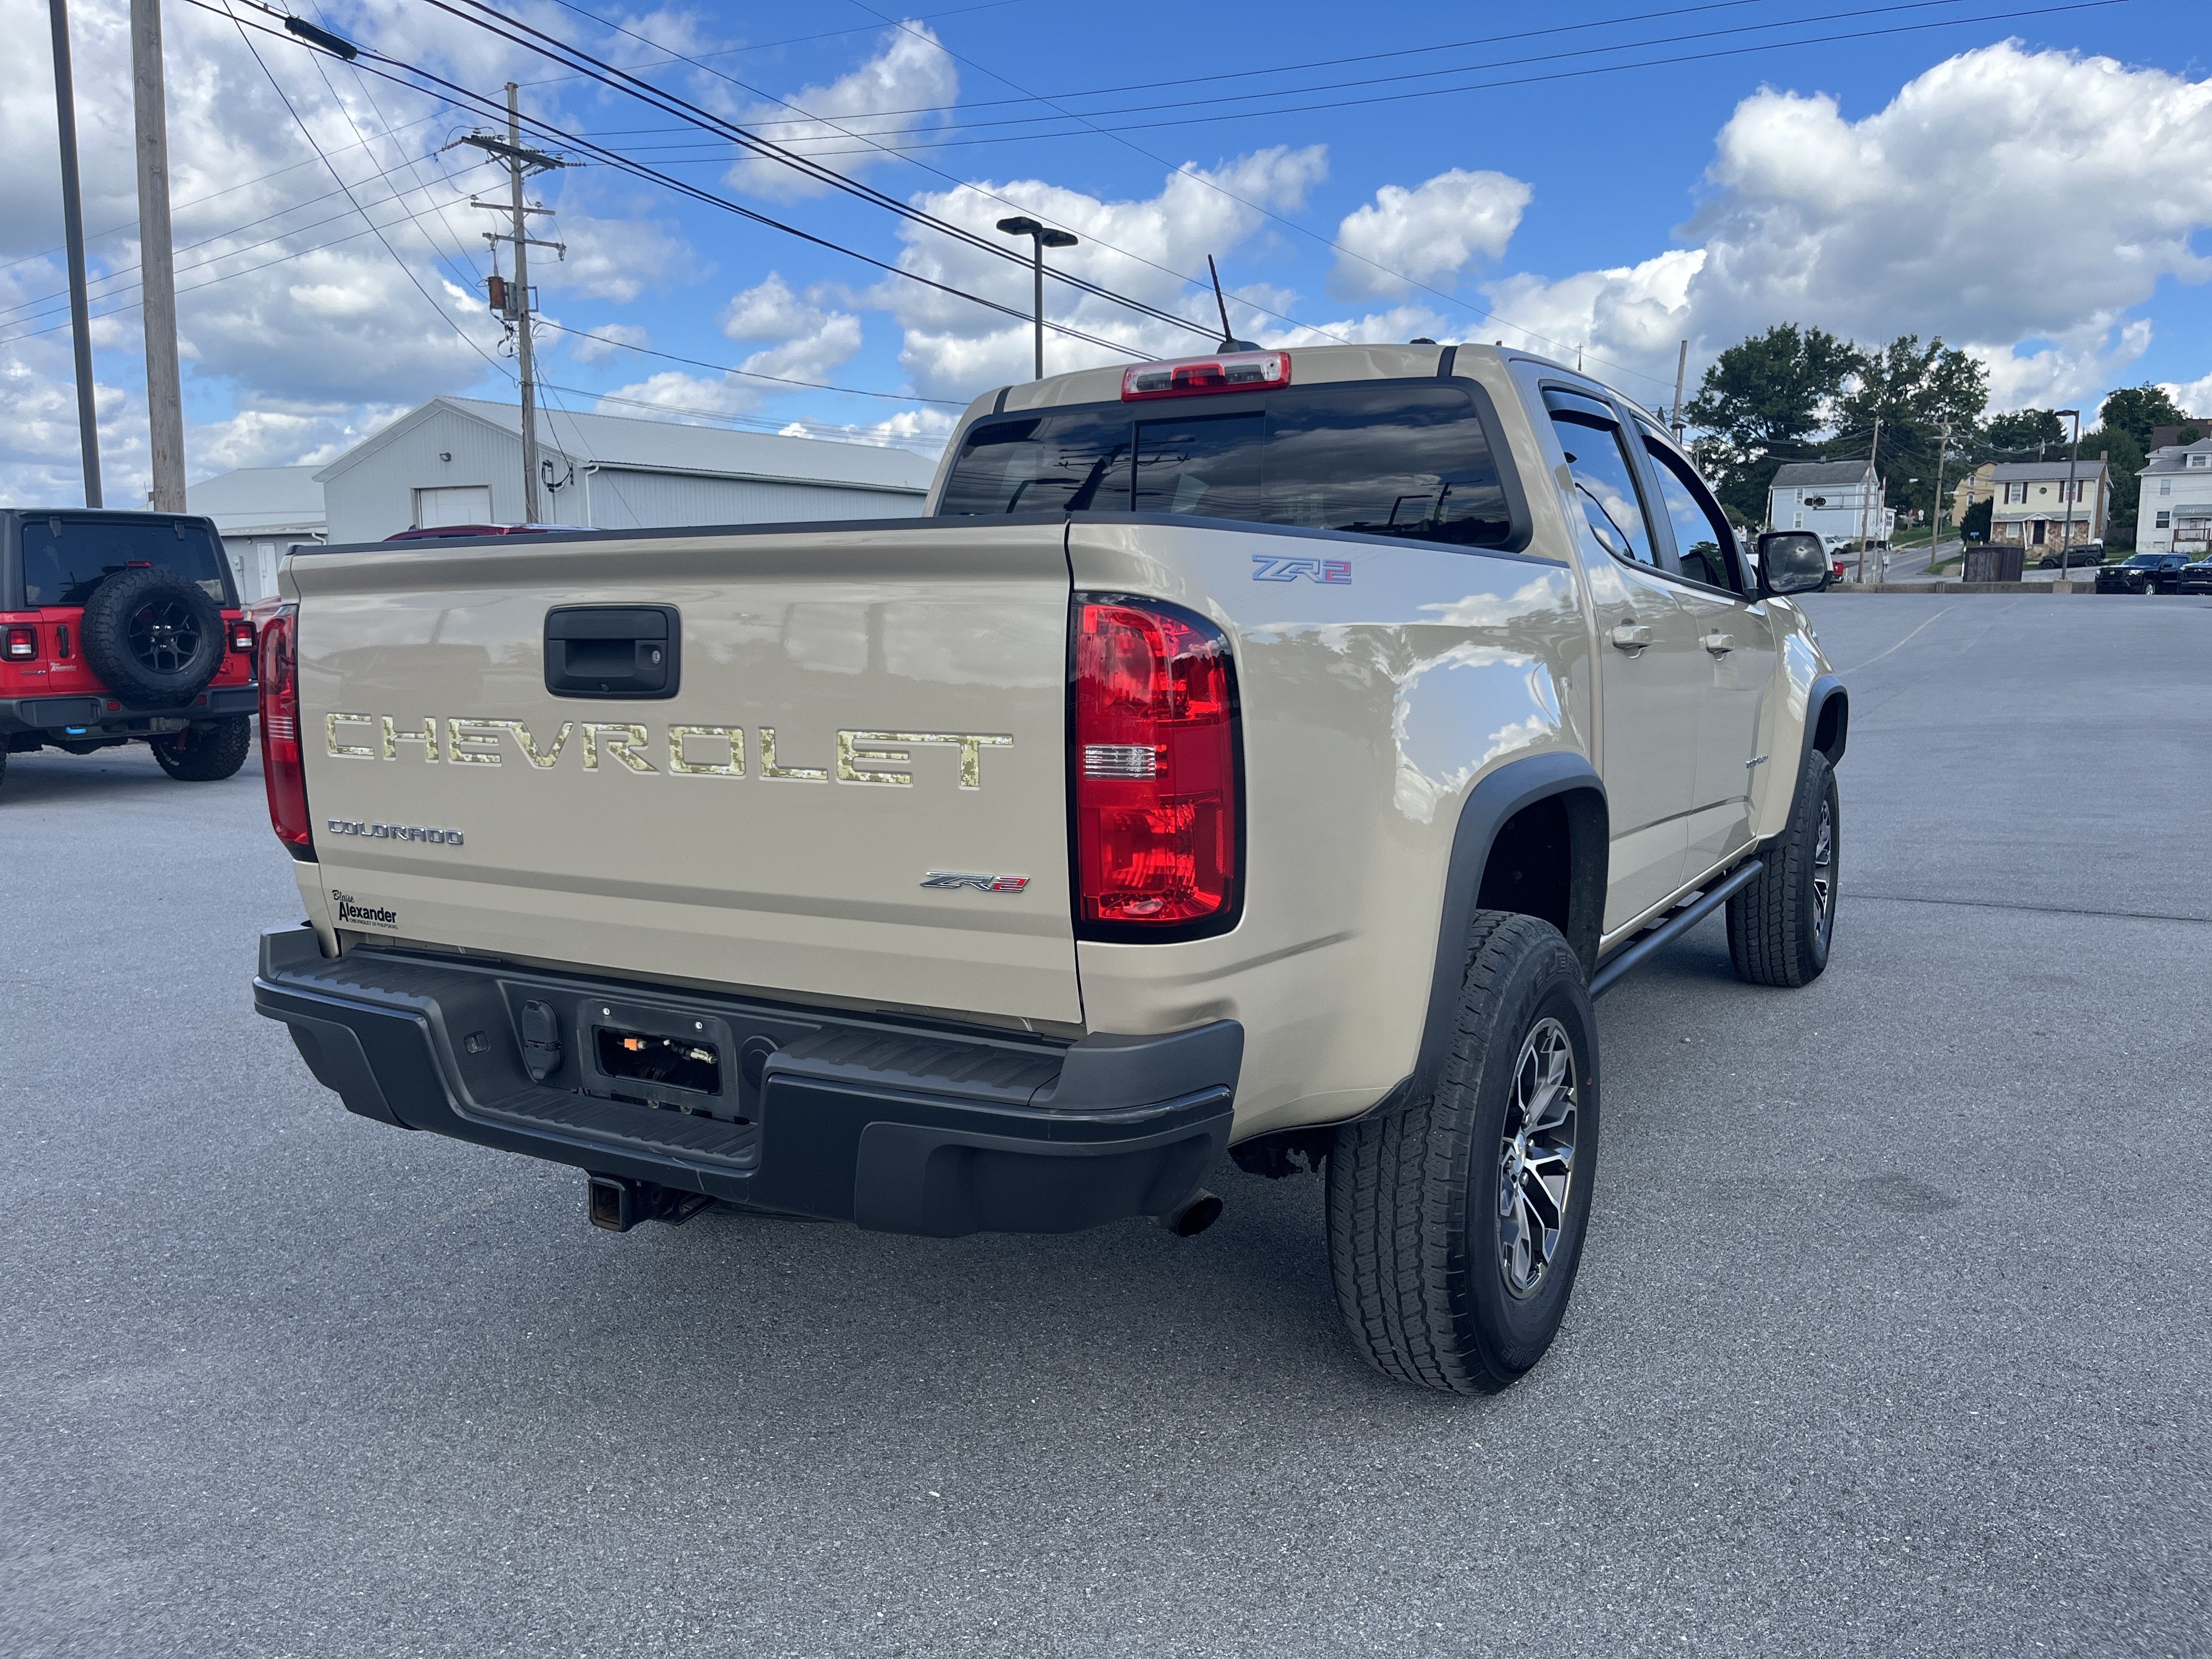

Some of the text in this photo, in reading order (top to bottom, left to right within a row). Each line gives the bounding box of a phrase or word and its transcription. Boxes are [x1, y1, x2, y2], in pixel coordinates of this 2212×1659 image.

[1251, 554, 1352, 586] ZR2
[326, 713, 1014, 788] CHEVROLET
[328, 819, 464, 845] COLORADO
[919, 871, 1031, 893] ZR2
[332, 889, 355, 903] Blaise
[339, 901, 397, 923] Alexander
